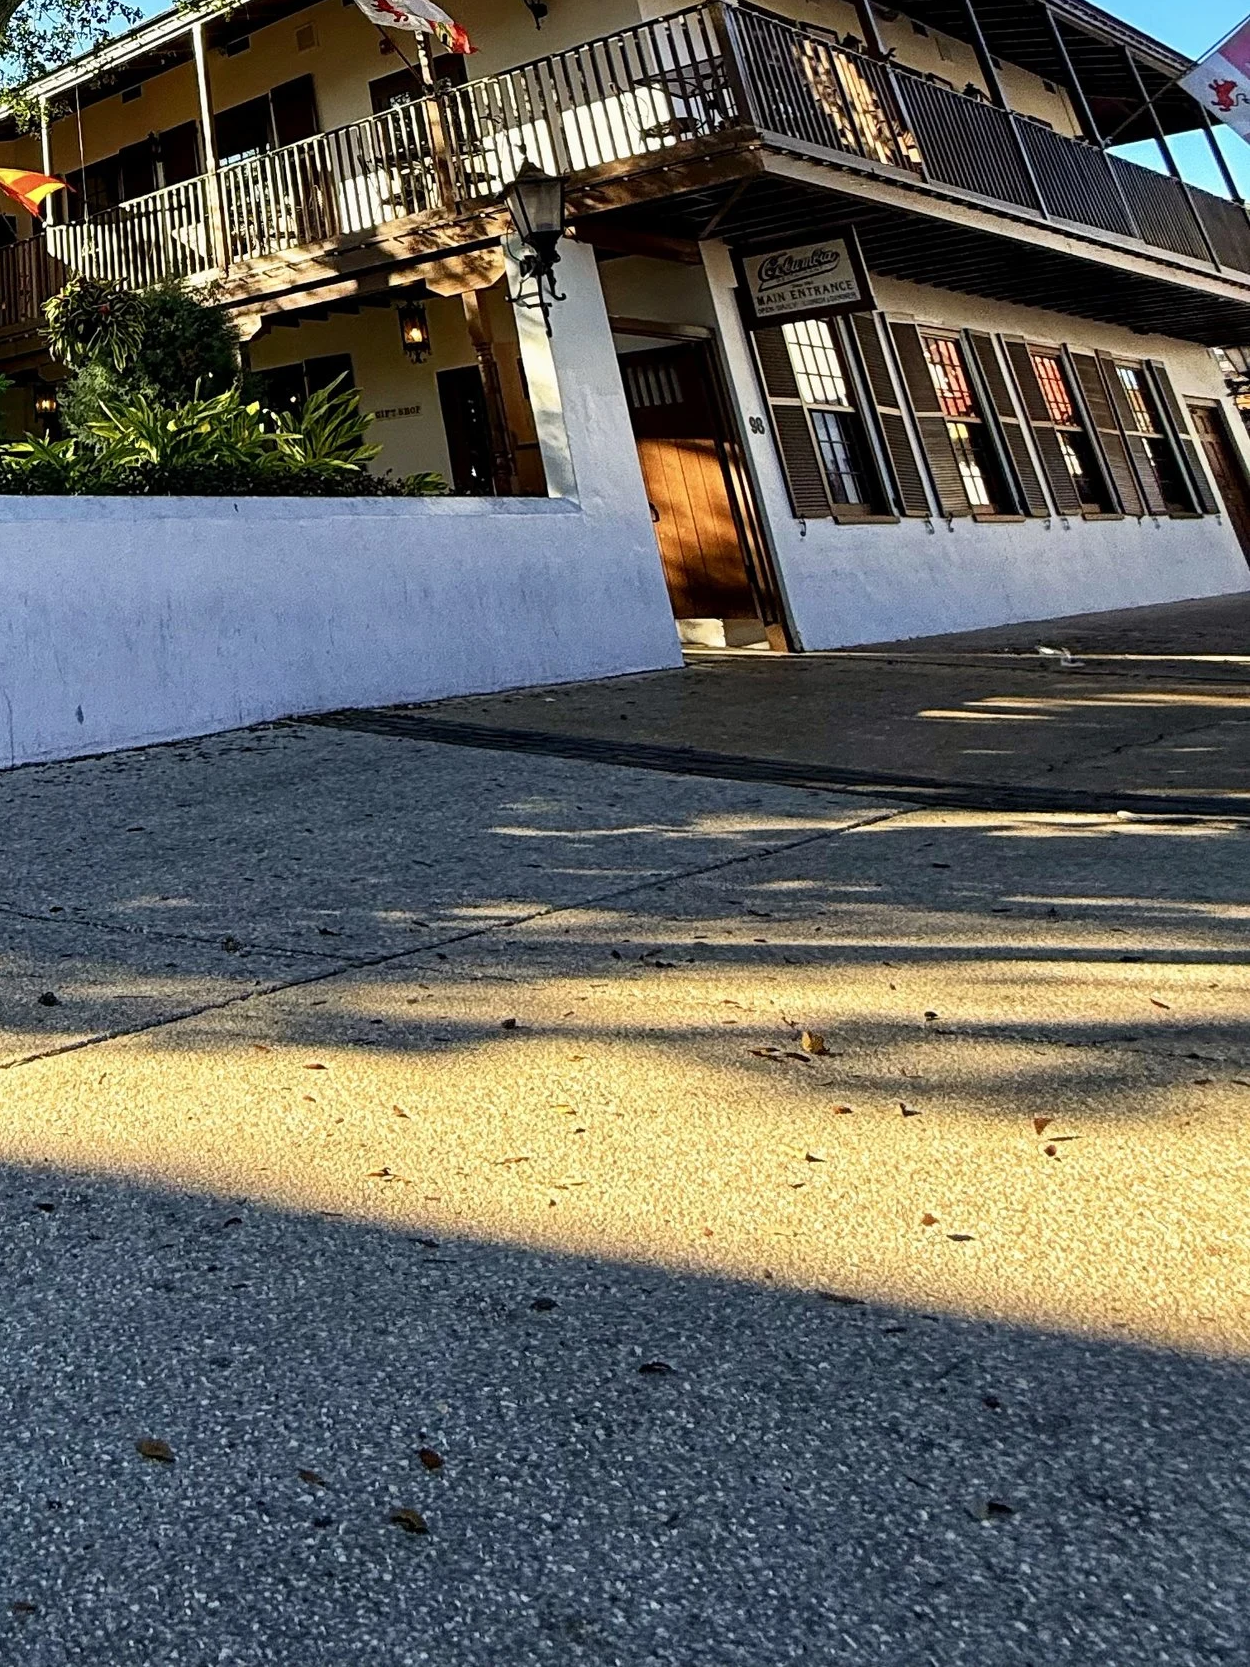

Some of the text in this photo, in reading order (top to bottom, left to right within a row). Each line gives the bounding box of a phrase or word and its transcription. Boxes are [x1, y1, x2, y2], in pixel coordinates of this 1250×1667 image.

[757, 293, 786, 306] MAIN
[791, 280, 855, 300] ENTRANCE
[749, 416, 765, 434] 98
